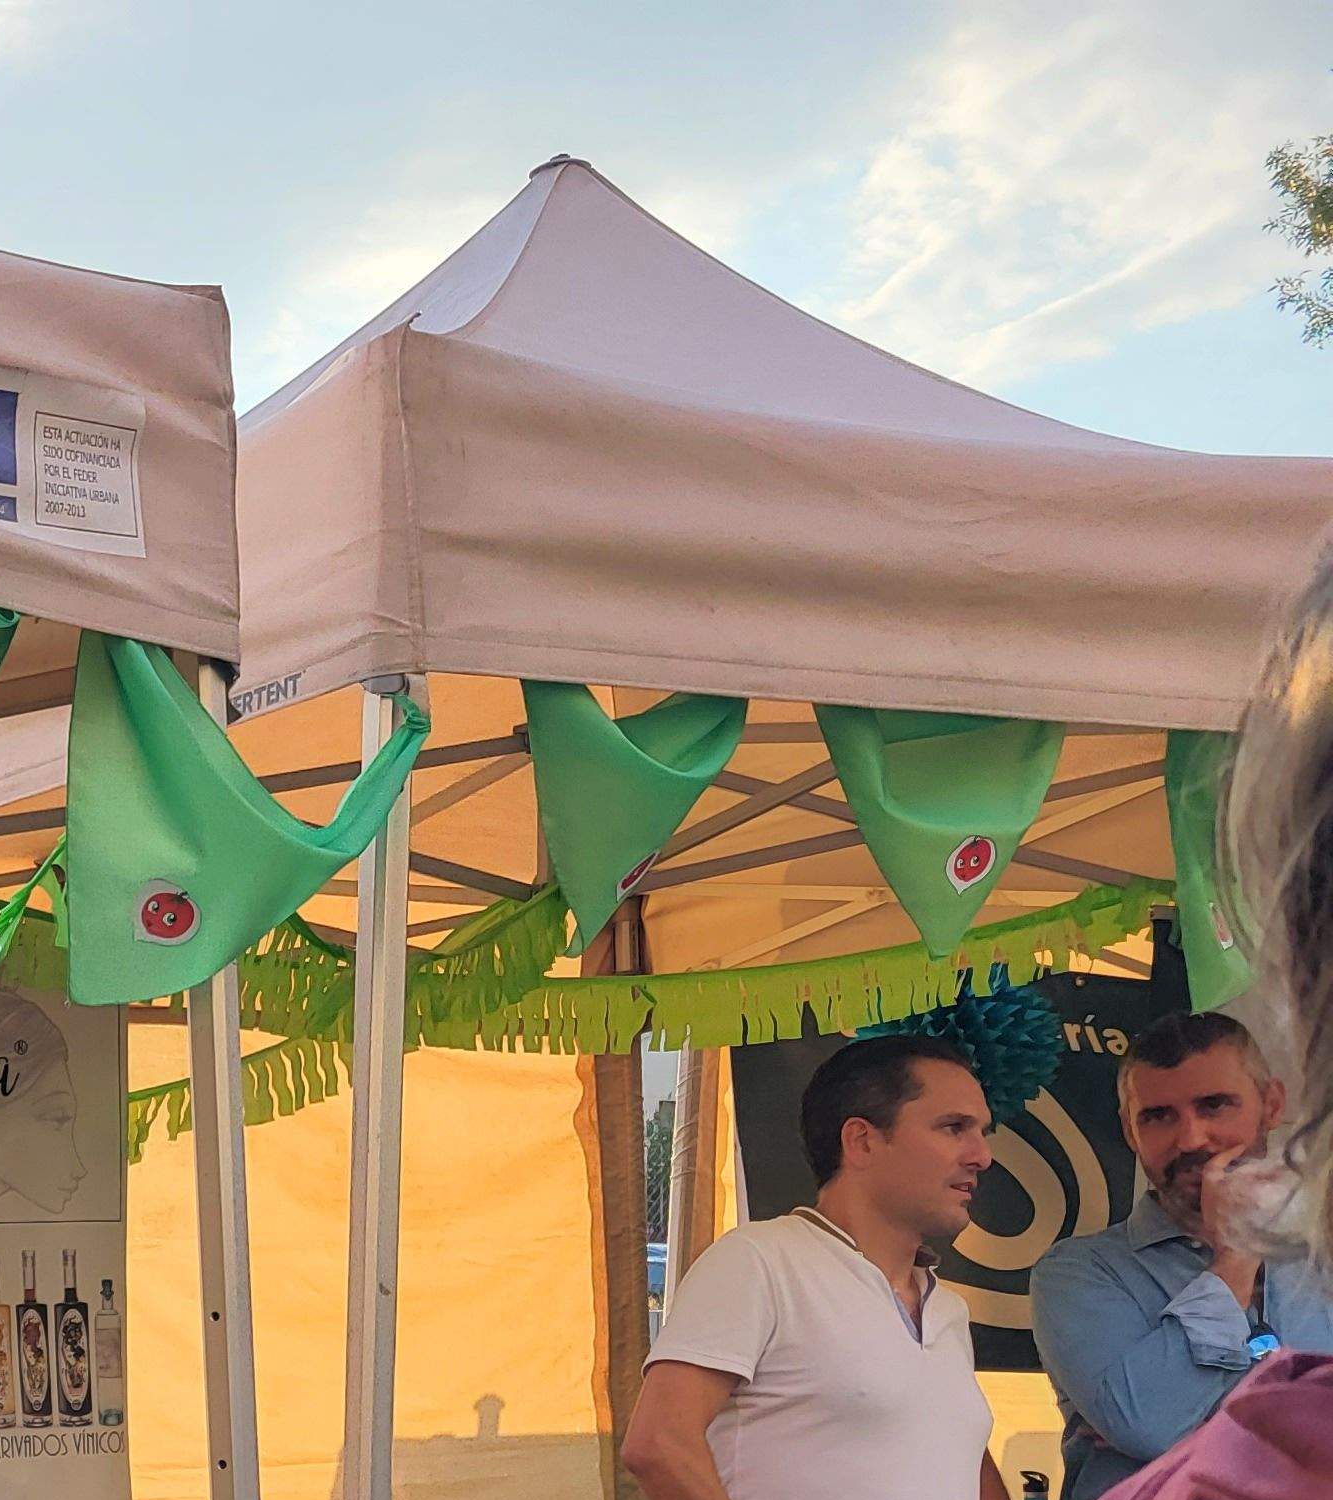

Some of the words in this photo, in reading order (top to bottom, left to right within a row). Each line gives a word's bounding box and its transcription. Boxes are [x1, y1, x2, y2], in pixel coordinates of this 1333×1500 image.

[43, 425, 62, 441] ESTA
[64, 428, 109, 449] ACTUACIÓN
[110, 438, 121, 450] HA
[43, 445, 63, 459] SIDO
[64, 449, 121, 469] COFINANCIADA
[44, 463, 61, 478] POR
[63, 467, 72, 480] EL
[74, 469, 98, 483] FEDER
[45, 482, 87, 499] INICIATIVA
[89, 488, 119, 505] URBANA
[45, 500, 86, 518] 2007-2013
[1062, 1014, 1130, 1056] ría
[72, 1429, 125, 1455] VÍNICOS
